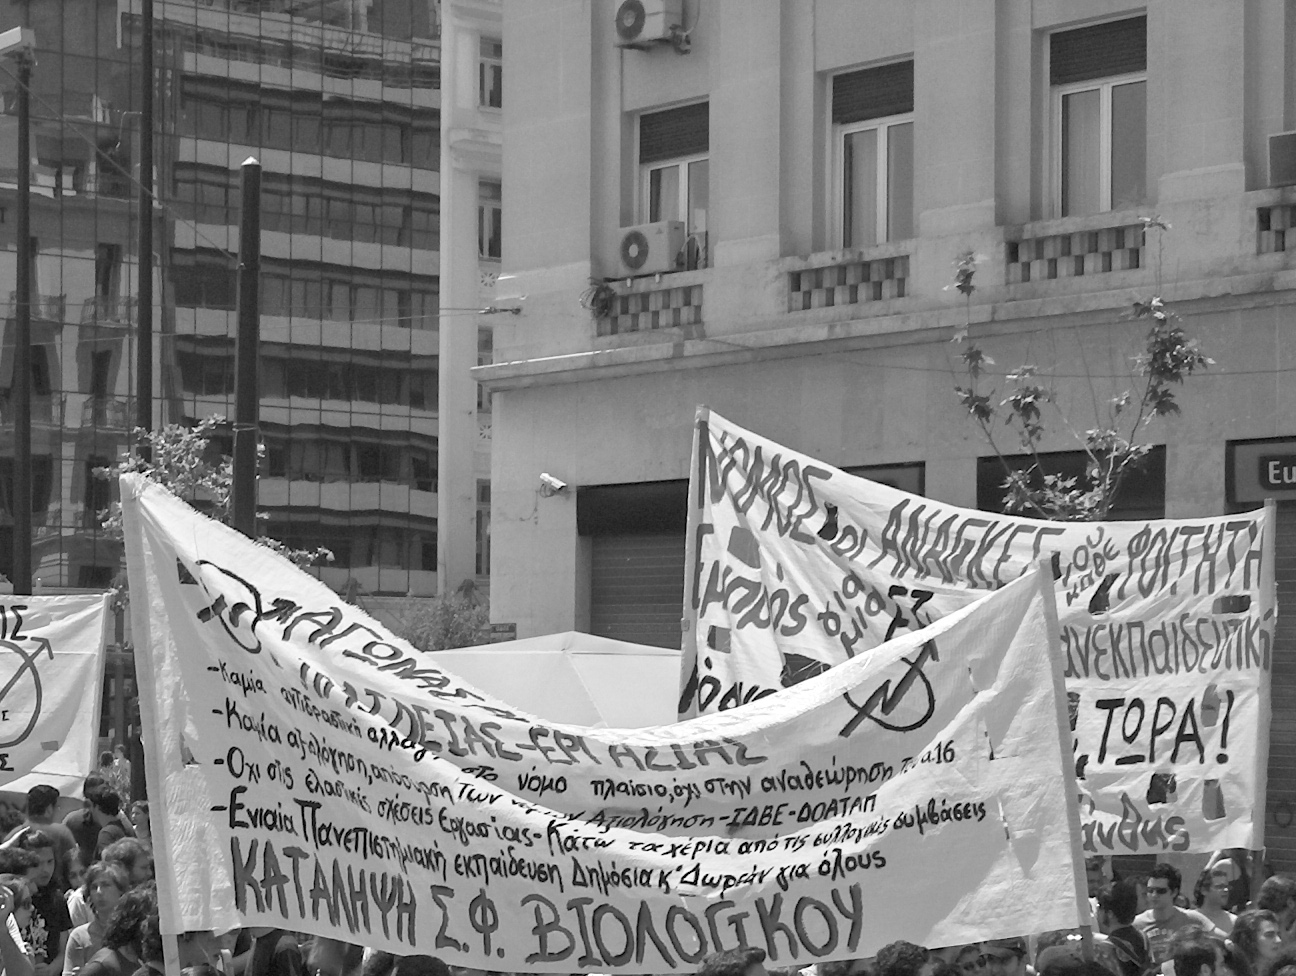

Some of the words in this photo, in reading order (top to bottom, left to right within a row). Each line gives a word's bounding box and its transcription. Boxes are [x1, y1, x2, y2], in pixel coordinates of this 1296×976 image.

[367, 726, 442, 763] αλλαγ
[518, 765, 567, 798] νόμο
[761, 755, 894, 794] αναθεώρηση
[1095, 689, 1235, 766] ΤΩΡΑ!
[377, 792, 434, 826] σχέσεις
[893, 798, 987, 836] συμβάσεις
[230, 836, 417, 947] ΚΑΤΑΛΗΨΗ
[521, 881, 864, 969] ΒΙΟΛΟΓΙΚΟΥ
[454, 847, 566, 893] εκπαίδευση
[572, 856, 653, 896] Δημόσια
[774, 861, 812, 892] για
[818, 848, 887, 882] όλους
